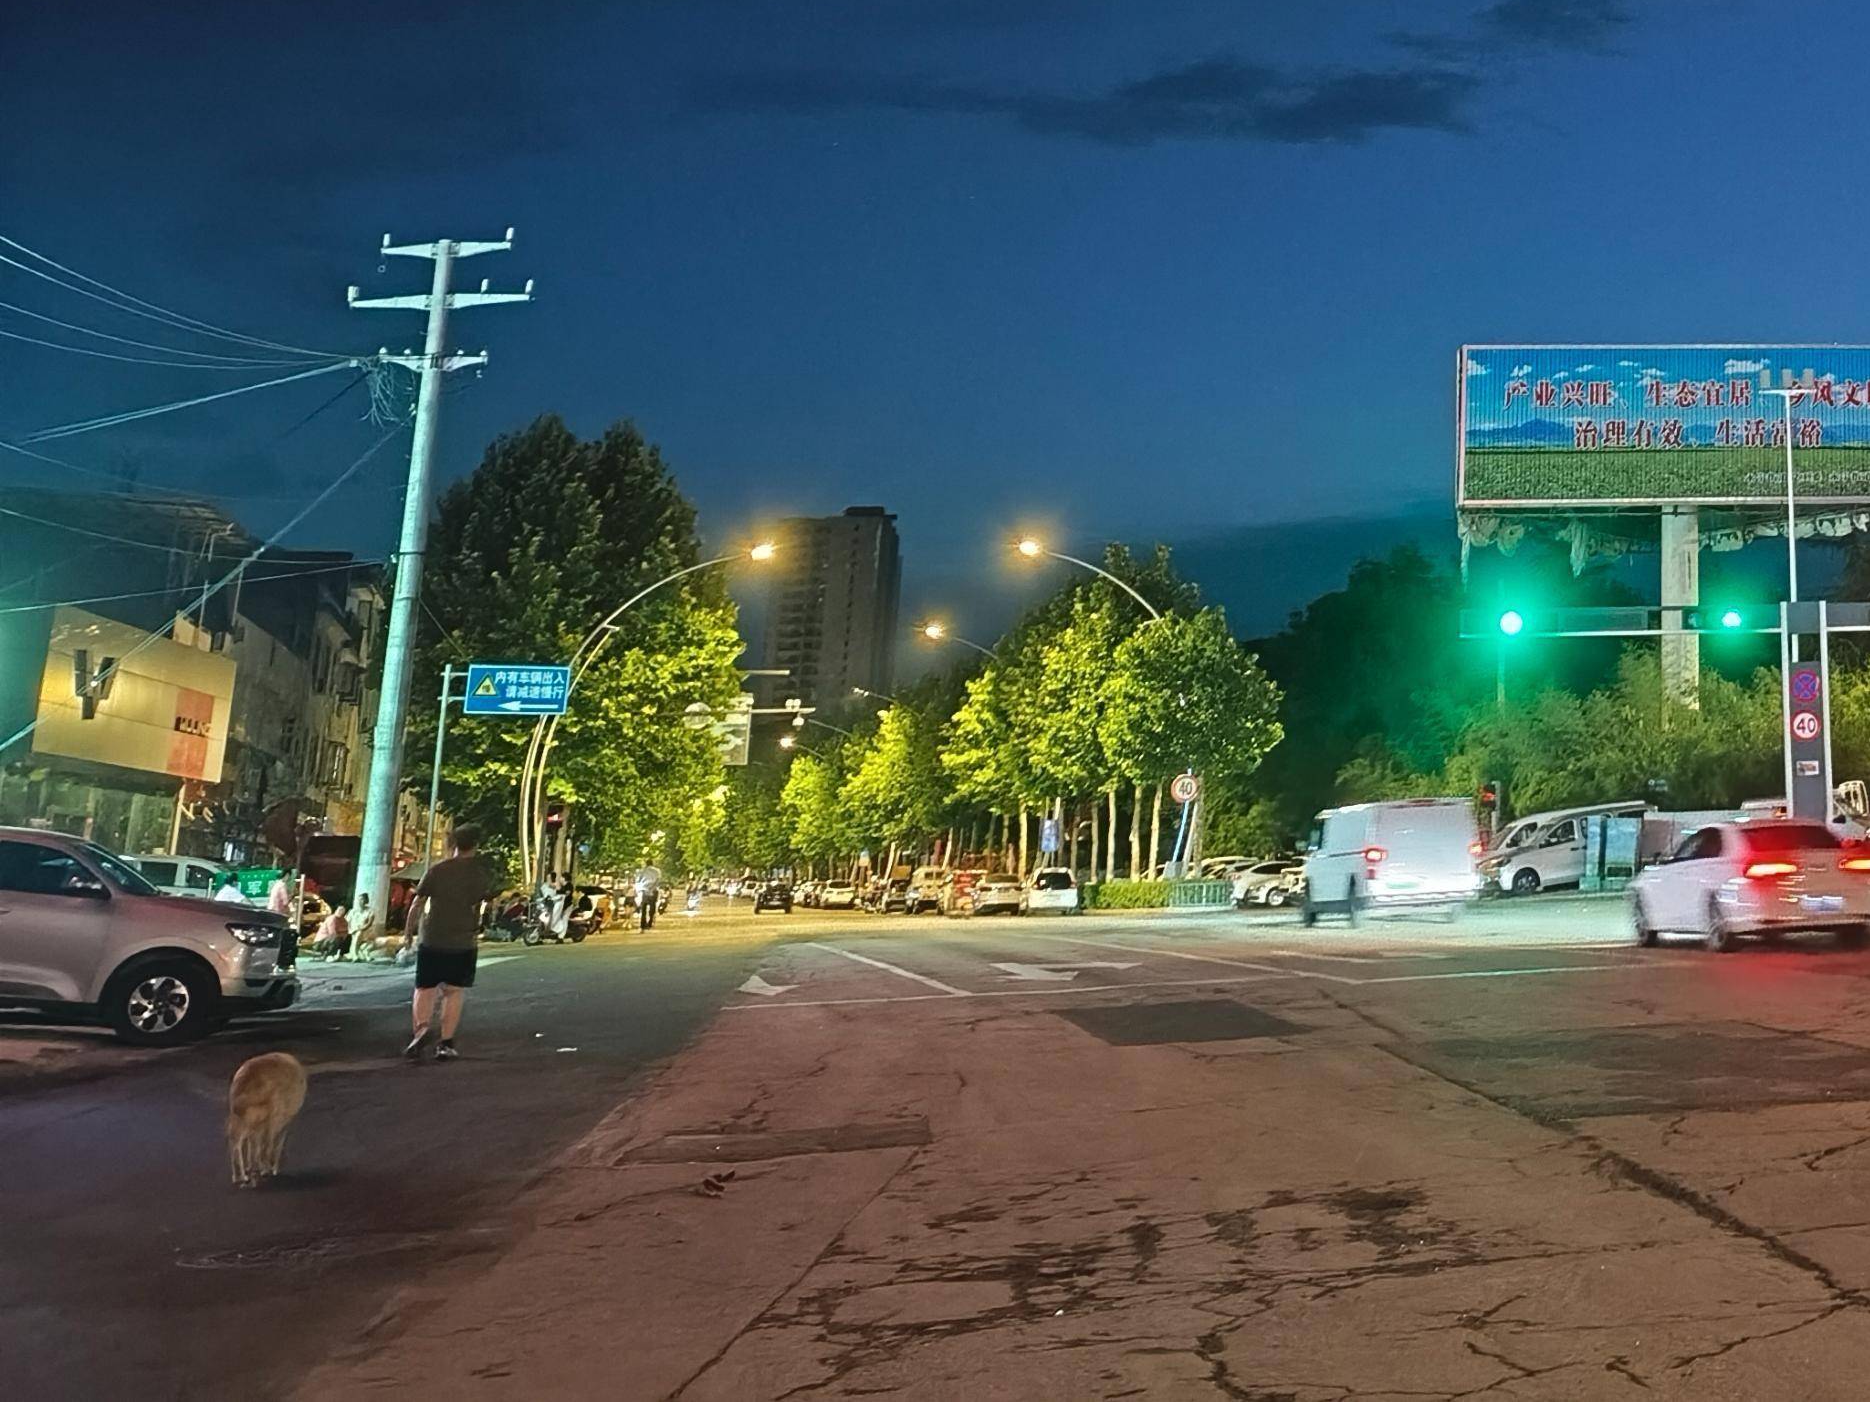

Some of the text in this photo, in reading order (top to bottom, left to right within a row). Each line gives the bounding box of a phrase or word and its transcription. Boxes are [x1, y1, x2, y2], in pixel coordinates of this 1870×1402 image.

[494, 671, 564, 685] 内有车辆出入
[505, 685, 564, 699] 请减速慢行
[1796, 717, 1816, 734] 40
[1178, 781, 1193, 796] 40
